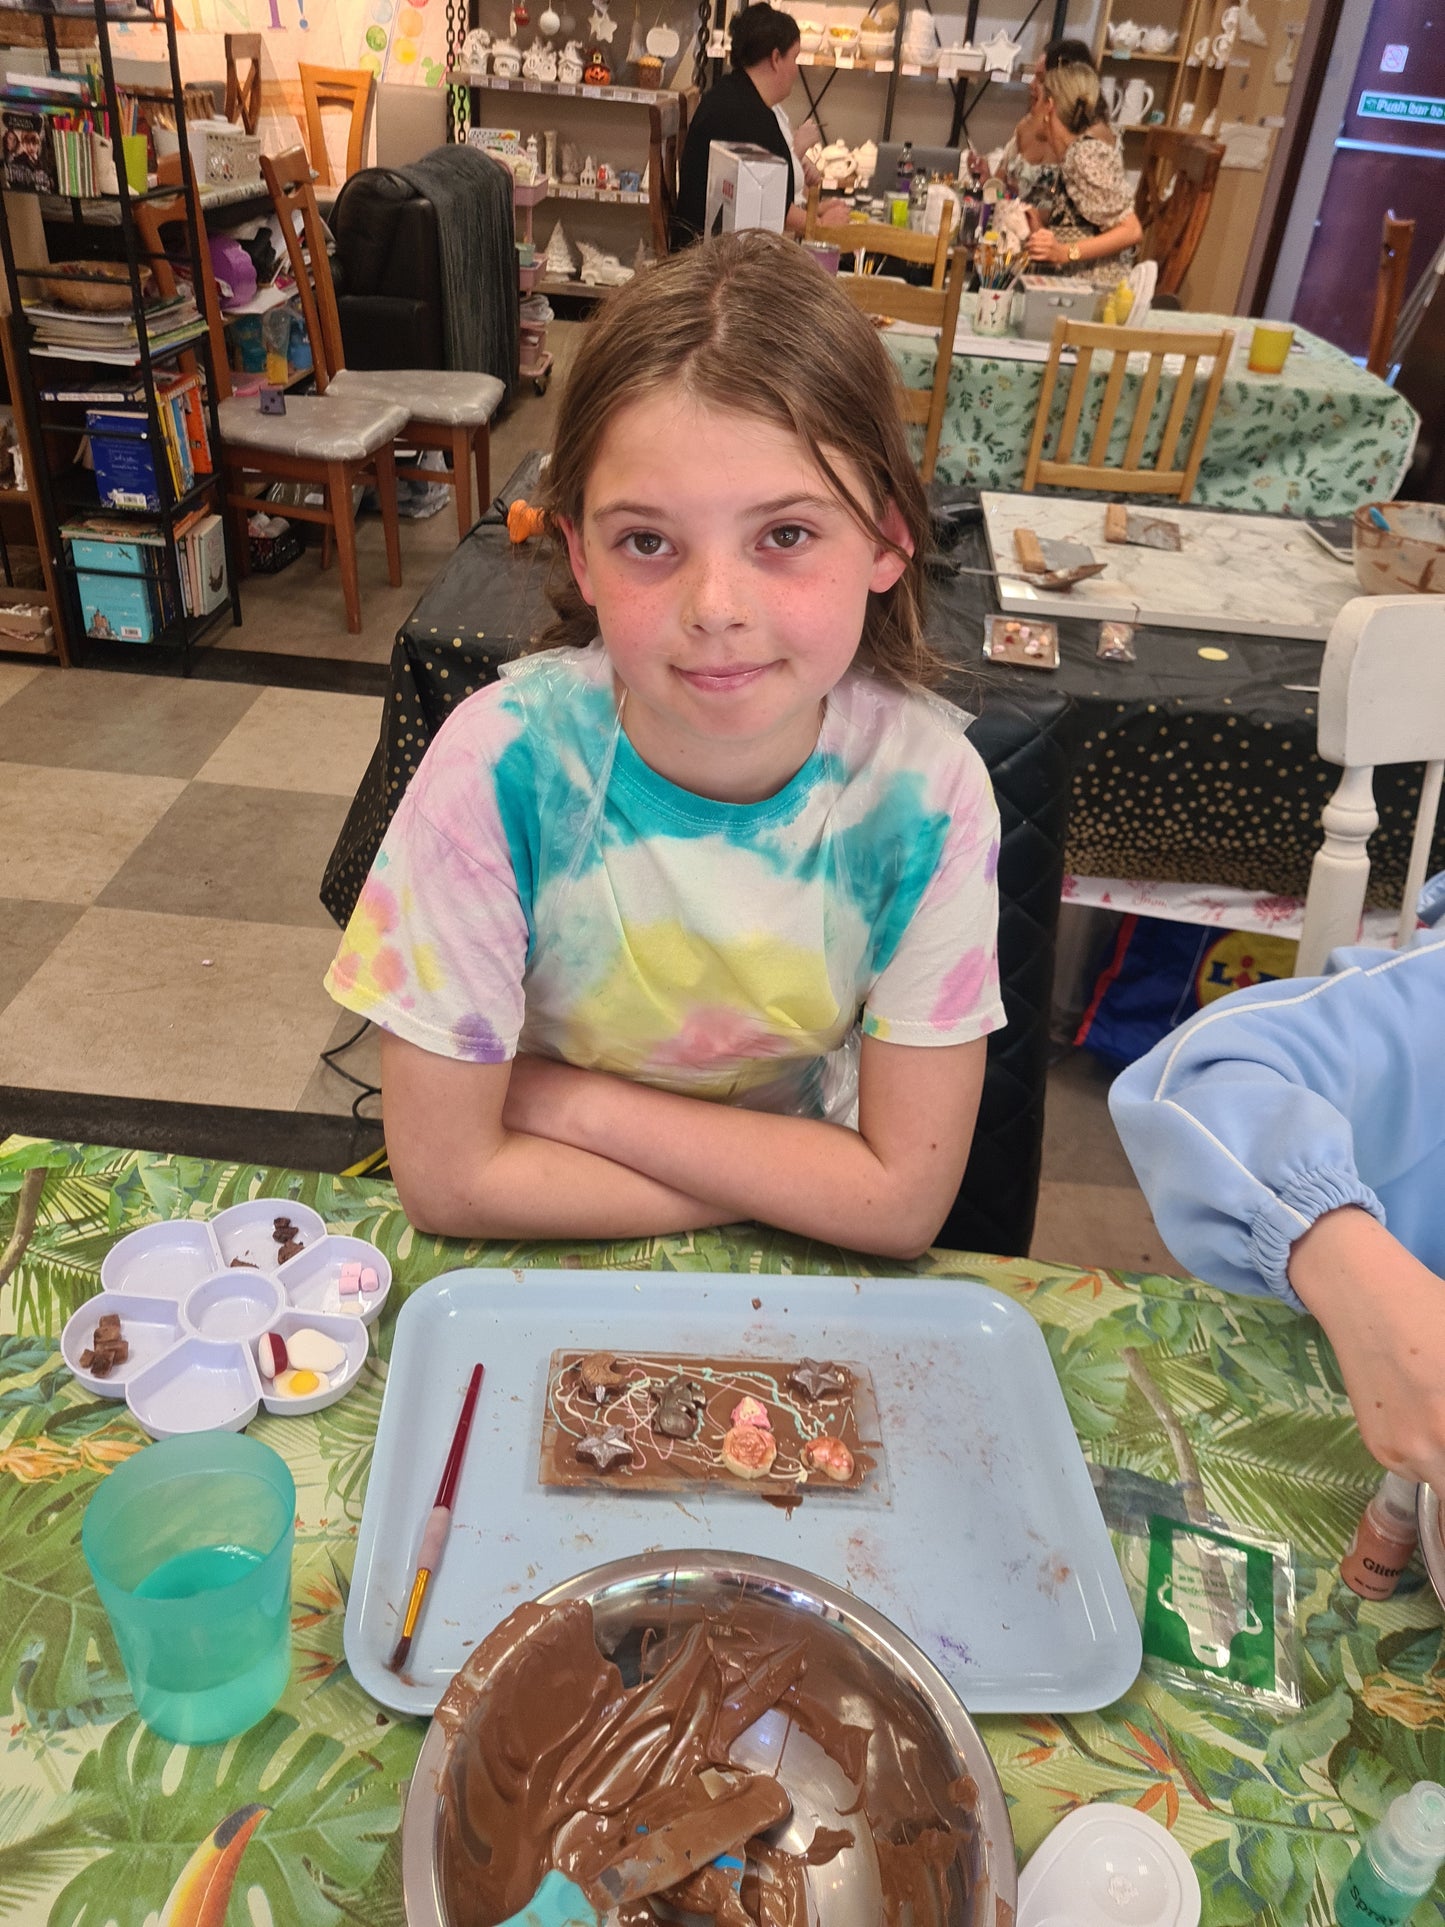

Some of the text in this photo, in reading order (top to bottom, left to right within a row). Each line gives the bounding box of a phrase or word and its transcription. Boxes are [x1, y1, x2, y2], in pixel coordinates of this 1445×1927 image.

[1376, 99, 1444, 118] Push bar to
